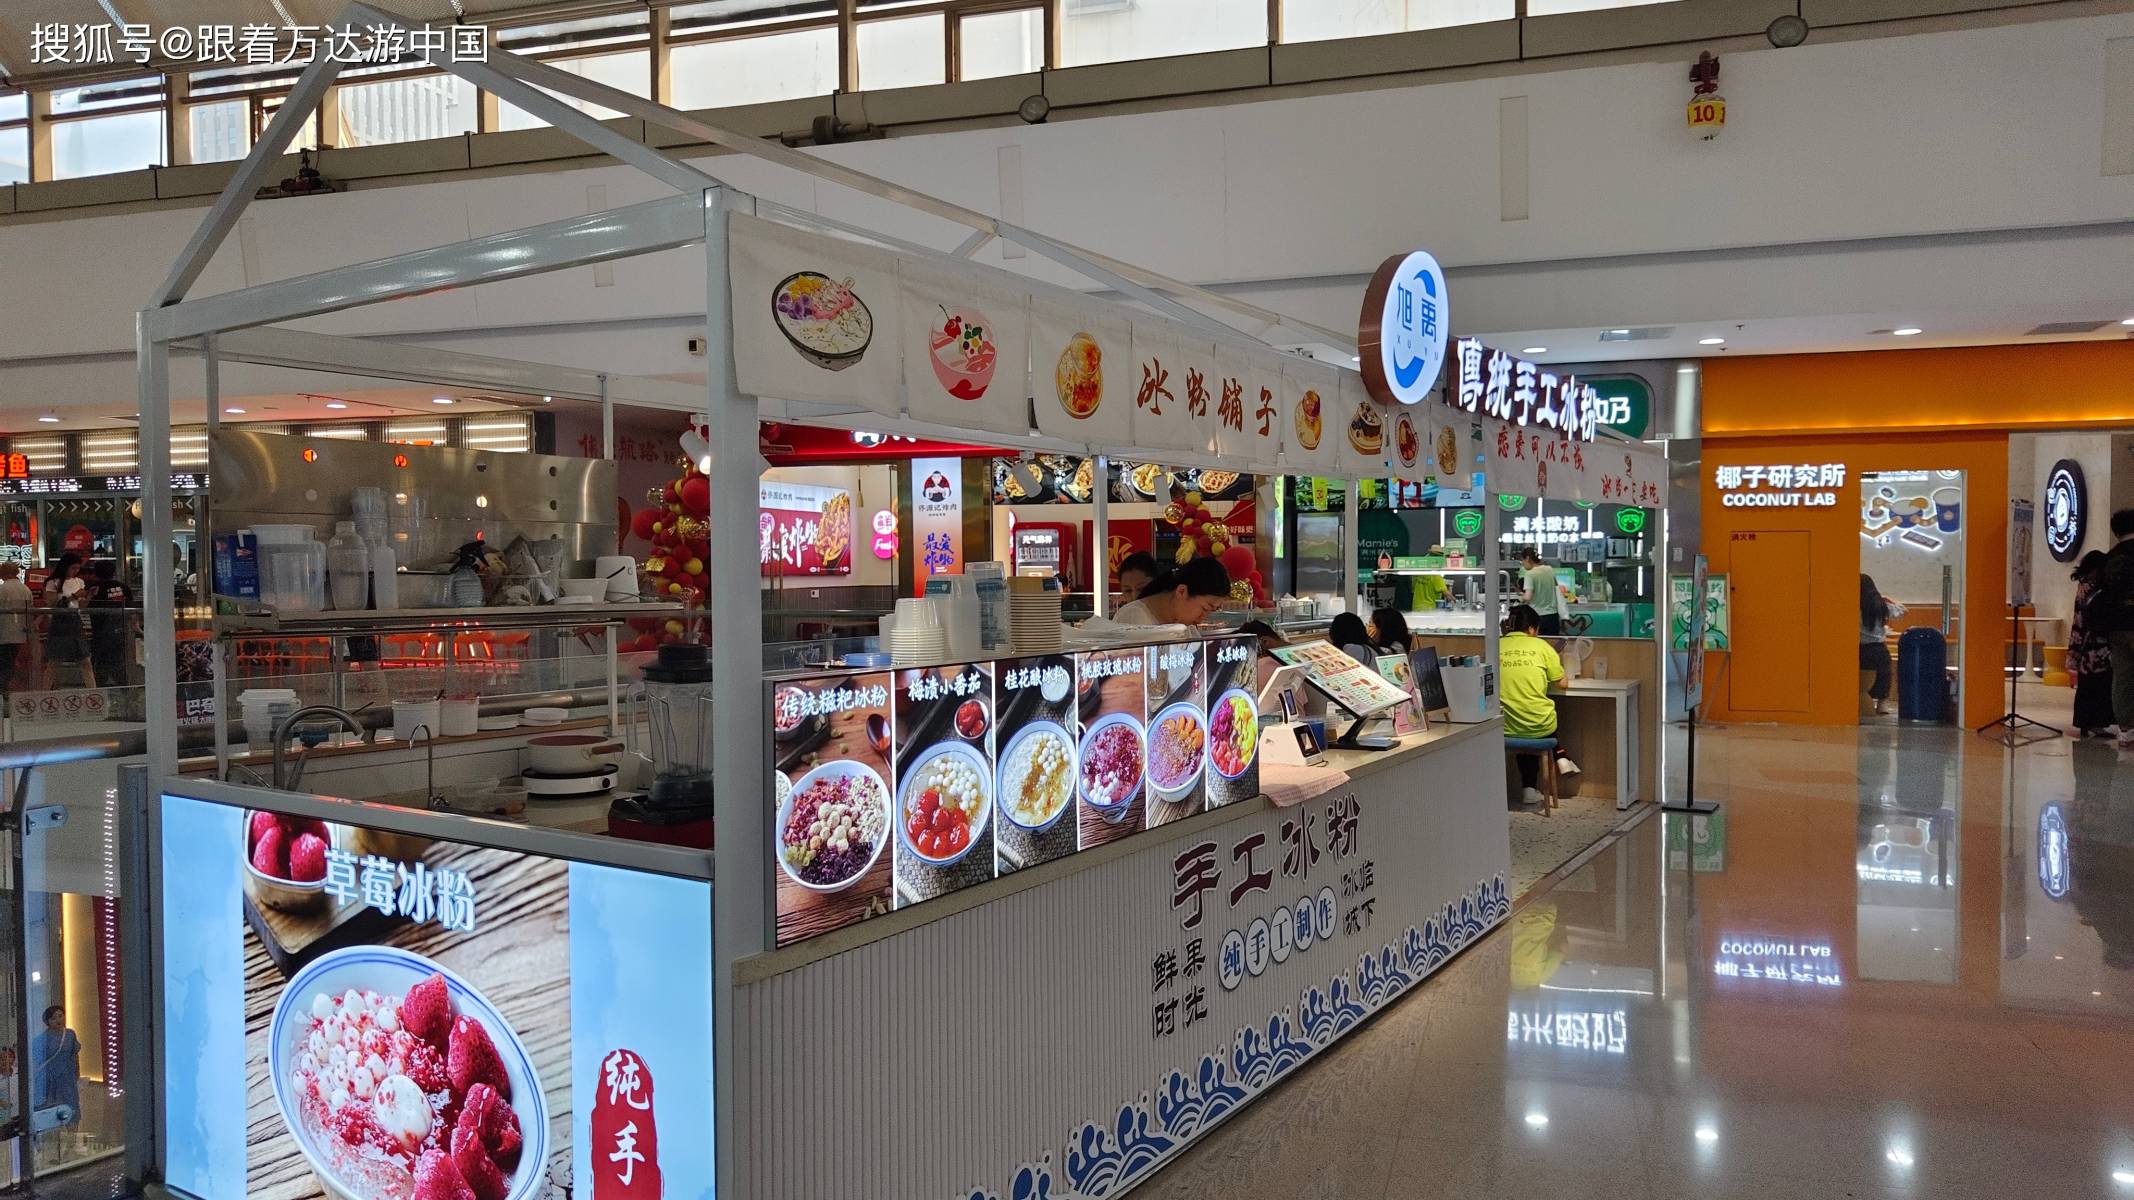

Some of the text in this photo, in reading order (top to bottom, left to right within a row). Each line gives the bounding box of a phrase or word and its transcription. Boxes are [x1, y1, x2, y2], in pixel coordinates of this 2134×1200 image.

[1694, 105, 1714, 123] 10
[1716, 463, 1845, 490] 椰子研究所
[1723, 491, 1836, 507] COCONUT LAB
[1081, 656, 1142, 680] 桃胶玫瑰冰粉
[1159, 653, 1195, 673] 酸梅冰粉
[1216, 647, 1247, 663] 水果冰粉
[908, 671, 981, 701] 梅渍小番茄
[1005, 665, 1066, 690] 桂花酿冰粉
[781, 684, 888, 718] 传统糍粑冰粉
[1172, 793, 1361, 931] 手工冰粉
[324, 848, 477, 933] 草莓冰粉
[1222, 898, 1333, 980] 纯手工制作
[605, 1050, 650, 1186] 纯手
